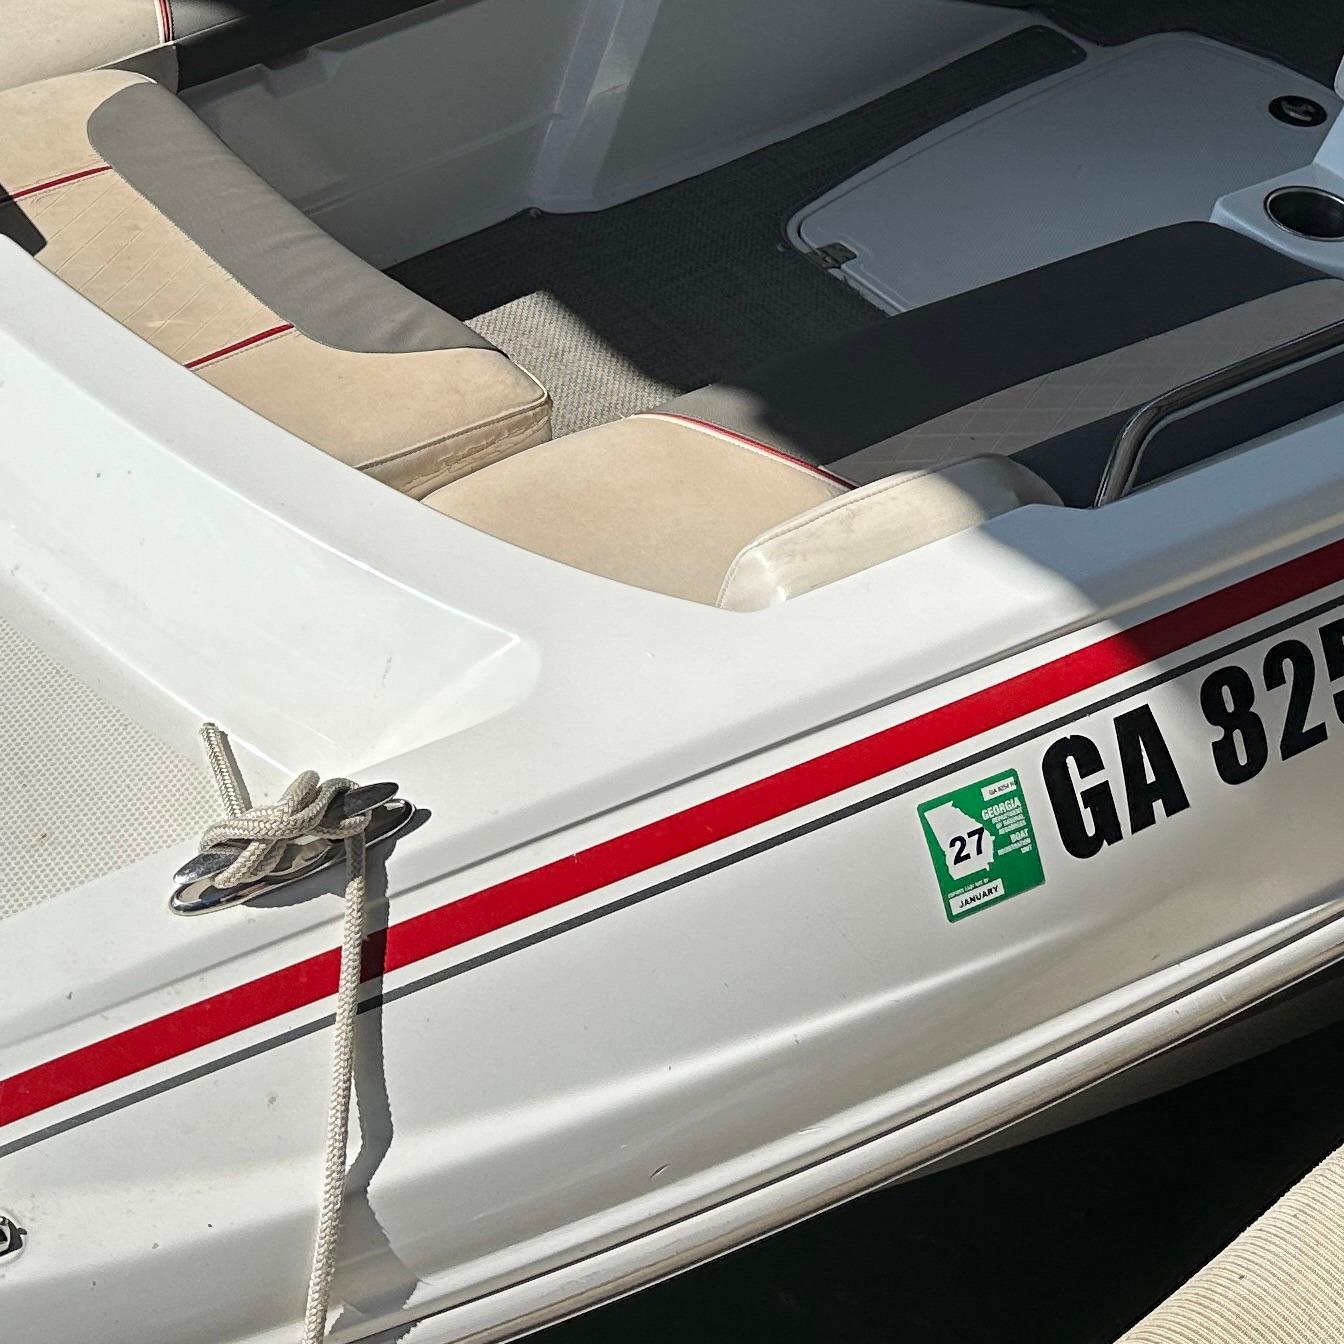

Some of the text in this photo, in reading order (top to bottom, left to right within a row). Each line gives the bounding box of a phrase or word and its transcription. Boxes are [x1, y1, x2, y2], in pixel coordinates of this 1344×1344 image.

[1042, 704, 1191, 859] GA
[981, 796, 1022, 820] GEORGIA
[949, 827, 985, 866] 27
[1009, 828, 1030, 844] BOAT
[958, 884, 999, 909] JANUARY
